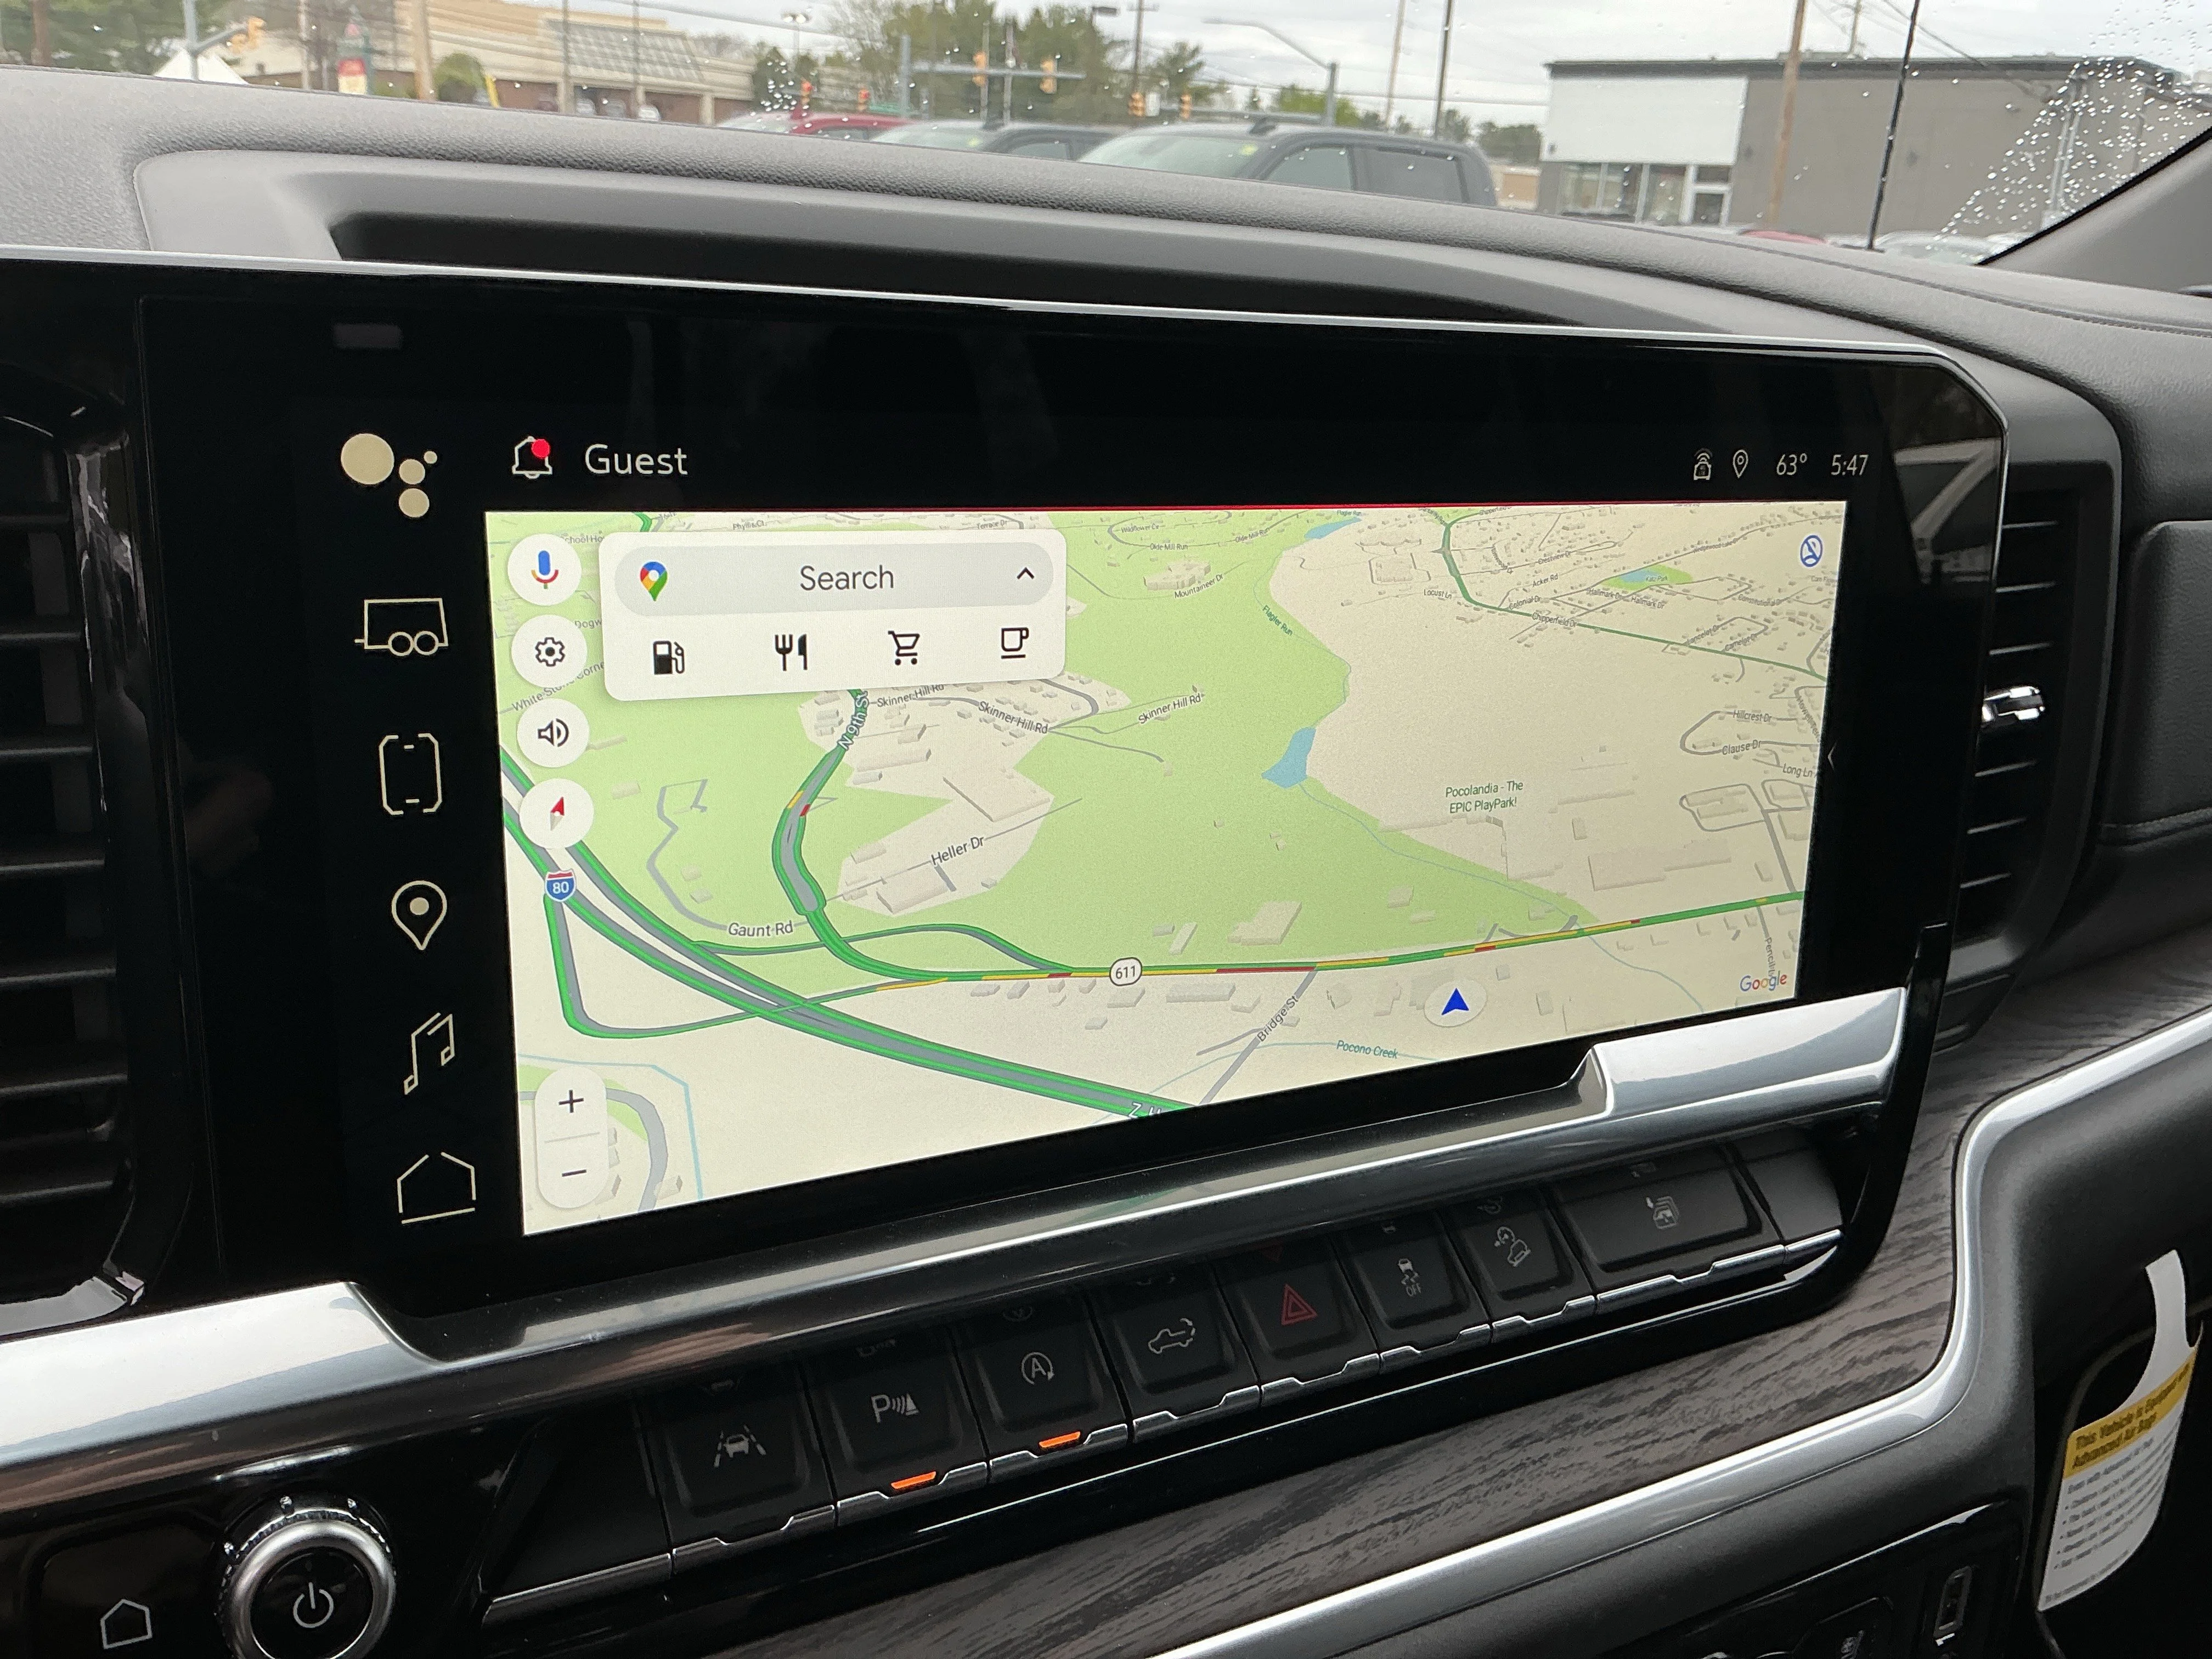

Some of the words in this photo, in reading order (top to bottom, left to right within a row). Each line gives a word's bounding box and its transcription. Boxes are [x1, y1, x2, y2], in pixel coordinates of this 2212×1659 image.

[585, 443, 689, 476] Guest
[1776, 453, 1808, 476] 63°
[1831, 454, 1869, 476] 5:47
[977, 521, 998, 530] Terrace
[562, 535, 589, 545] chool
[1235, 534, 1248, 543] Olde
[1248, 531, 1259, 540] Mill
[1259, 527, 1271, 537] Run
[1164, 542, 1175, 550] Mill
[1538, 553, 1565, 565] Crestview
[800, 565, 894, 591] Search
[1174, 578, 1215, 599] Mountaineer
[1216, 573, 1224, 583] Dr
[1532, 577, 1549, 588] Acker
[1550, 573, 1559, 582] Rd
[1424, 589, 1444, 598] Locust
[1509, 596, 1534, 610] Colonial
[1534, 595, 1542, 603] Dr
[1262, 605, 1282, 627] Flagler
[1281, 623, 1293, 636] Run
[1532, 612, 1568, 627] Chipperfield
[1569, 619, 1577, 628] Dr
[512, 692, 544, 711] White
[855, 691, 868, 708] St
[877, 693, 913, 708] Skinner
[915, 687, 930, 699] Hill
[1138, 704, 1171, 724] Skinner
[1173, 697, 1187, 709] Hill
[1189, 693, 1201, 704] Rd
[1733, 709, 1763, 721] Hillcrest
[1763, 713, 1773, 723] Dr
[847, 712, 866, 736] 9th
[978, 701, 1015, 724] Skinner
[1017, 716, 1035, 732] Hill
[1035, 723, 1048, 734] Rd
[838, 735, 853, 751] N
[1722, 743, 1751, 755] Clause
[1752, 739, 1762, 749] Dr
[1783, 763, 1802, 778] Long
[1803, 767, 1813, 778] Ln
[1446, 782, 1498, 798] Pocolandia
[1506, 780, 1523, 792] The
[1449, 801, 1472, 814] EPIC
[1474, 796, 1517, 813] PlayPark!
[931, 843, 967, 865] Heller
[970, 837, 984, 849] Dr
[552, 881, 569, 894] 80
[728, 922, 771, 936] Gaunt
[776, 919, 793, 935] Rd
[1115, 964, 1137, 980] 611
[1740, 970, 1787, 991] Google
[1256, 1008, 1288, 1042] Bridge
[1286, 996, 1299, 1009] St
[1336, 1040, 1372, 1054] Pocono
[1373, 1046, 1398, 1059] Creek
[1406, 1282, 1421, 1297] OFF
[871, 1394, 891, 1423] P
